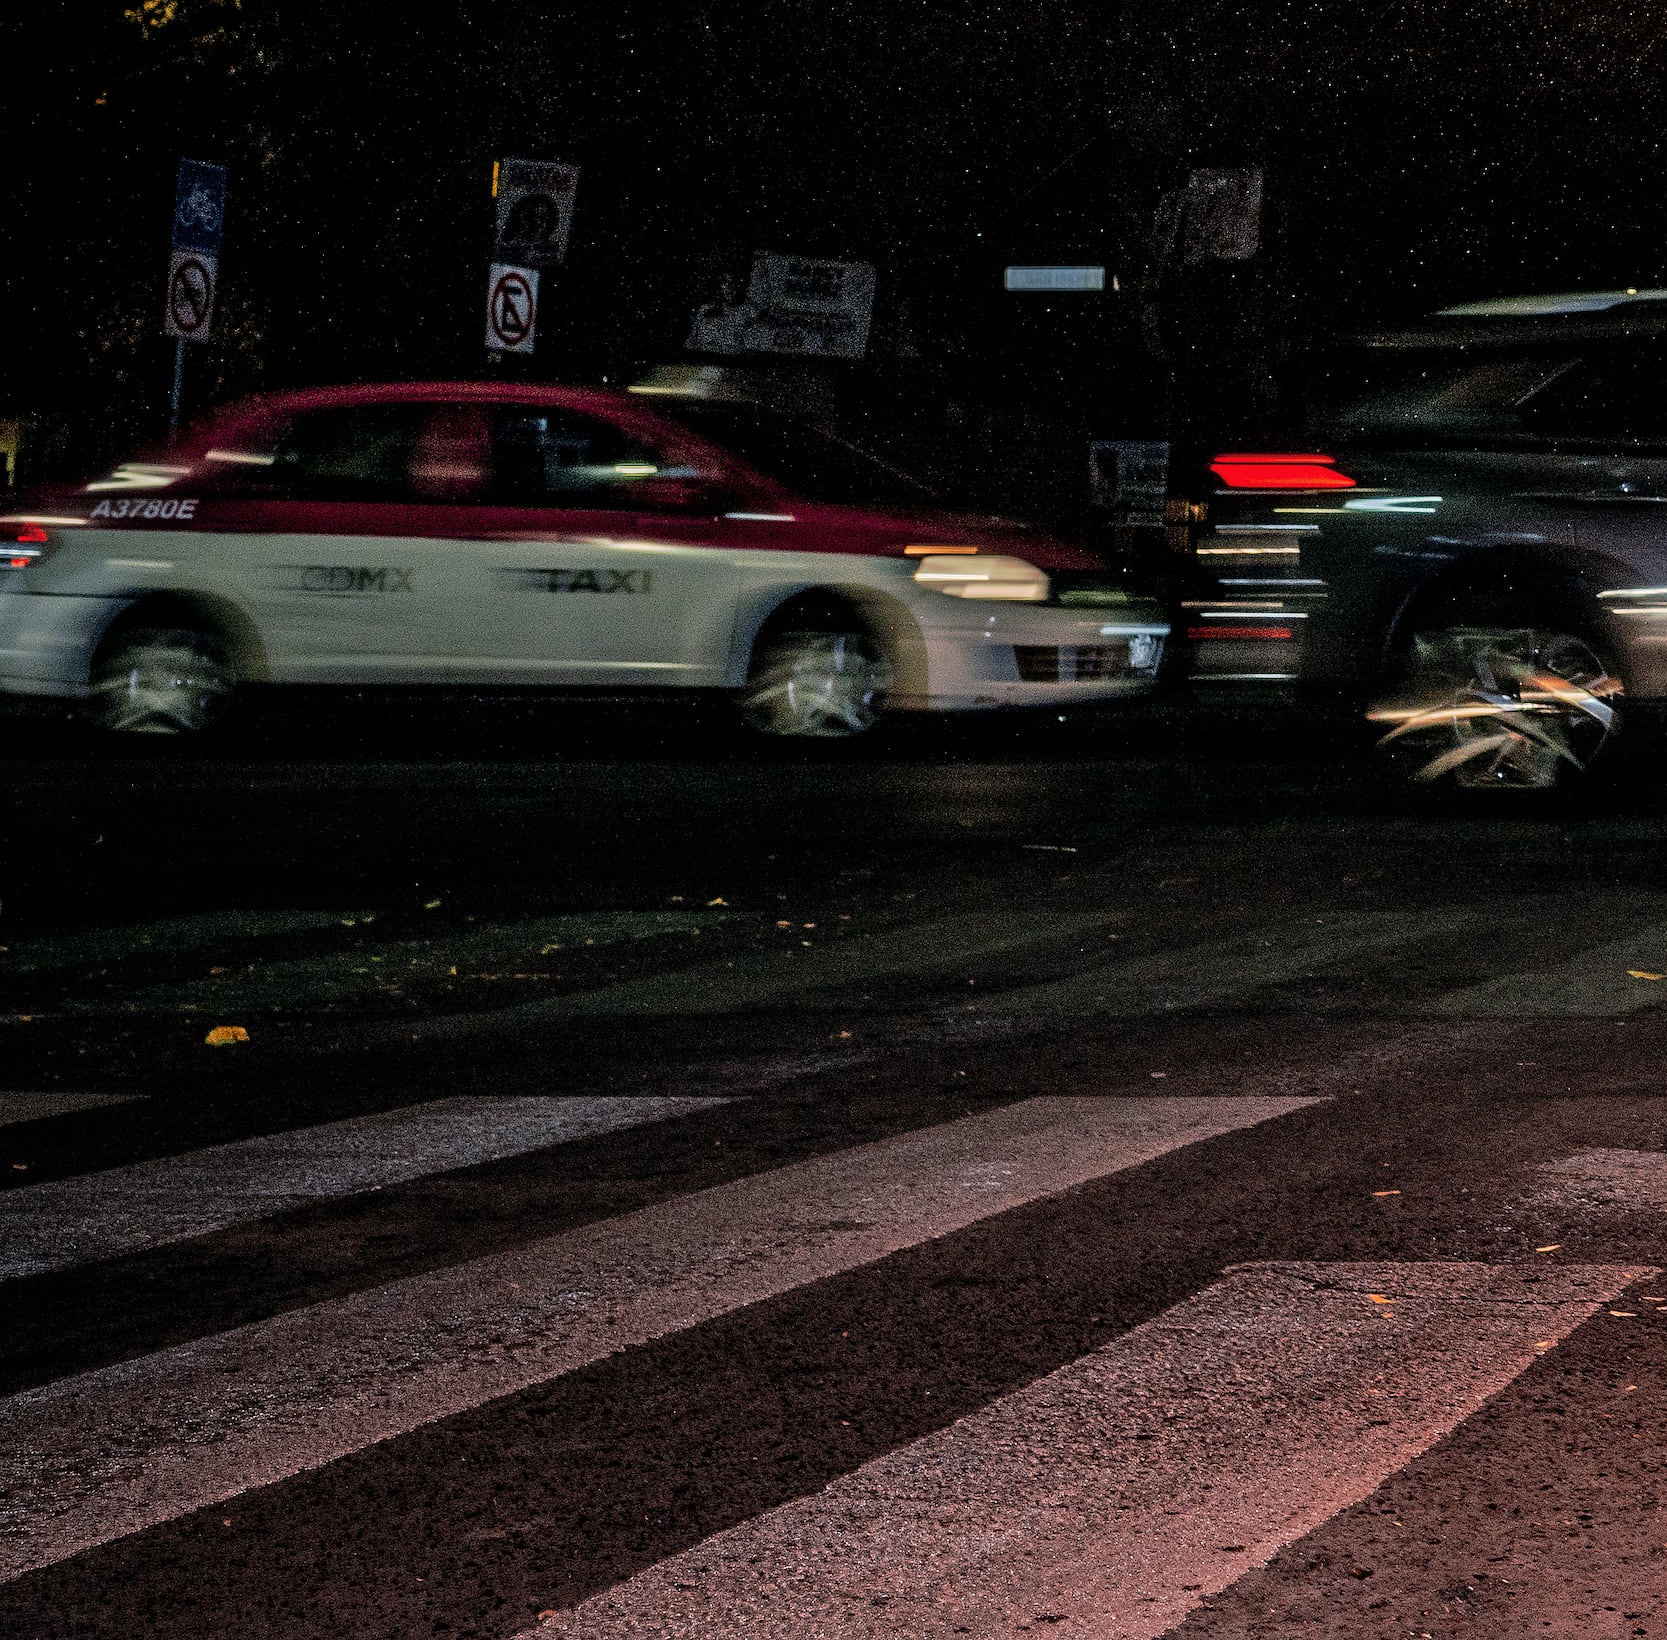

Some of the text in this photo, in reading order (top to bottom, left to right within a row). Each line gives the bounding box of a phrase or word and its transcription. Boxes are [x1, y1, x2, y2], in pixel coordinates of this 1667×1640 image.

[91, 498, 199, 521] A3780E
[301, 566, 415, 593] CDMX
[543, 567, 653, 594] TAXI
